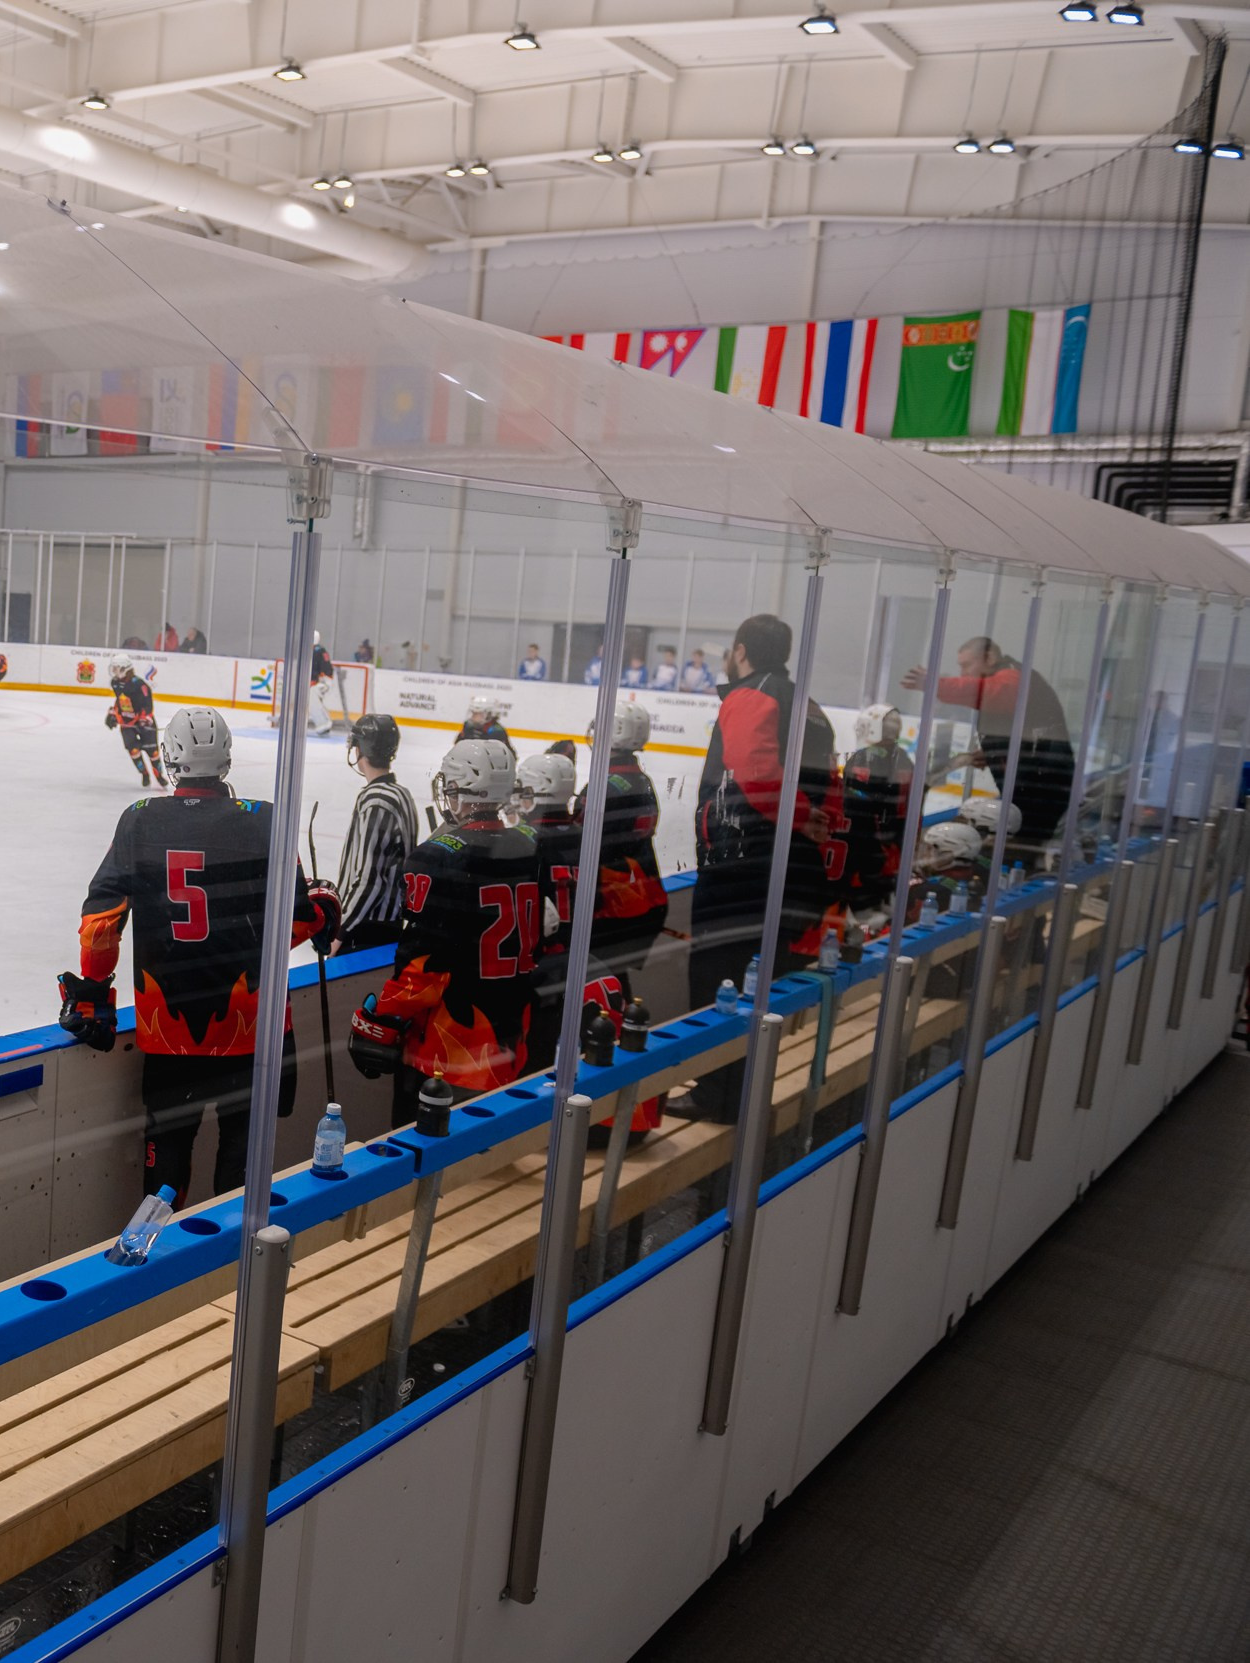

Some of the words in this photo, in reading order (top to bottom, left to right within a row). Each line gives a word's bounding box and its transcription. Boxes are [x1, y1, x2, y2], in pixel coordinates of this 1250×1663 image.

[70, 649, 101, 657] CHILDREN
[399, 692, 436, 702] NATURAL
[399, 700, 437, 711] ADVANCE
[166, 850, 210, 943] 5
[403, 872, 432, 914] 20
[479, 881, 540, 980] 20
[145, 1141, 156, 1168] 5
